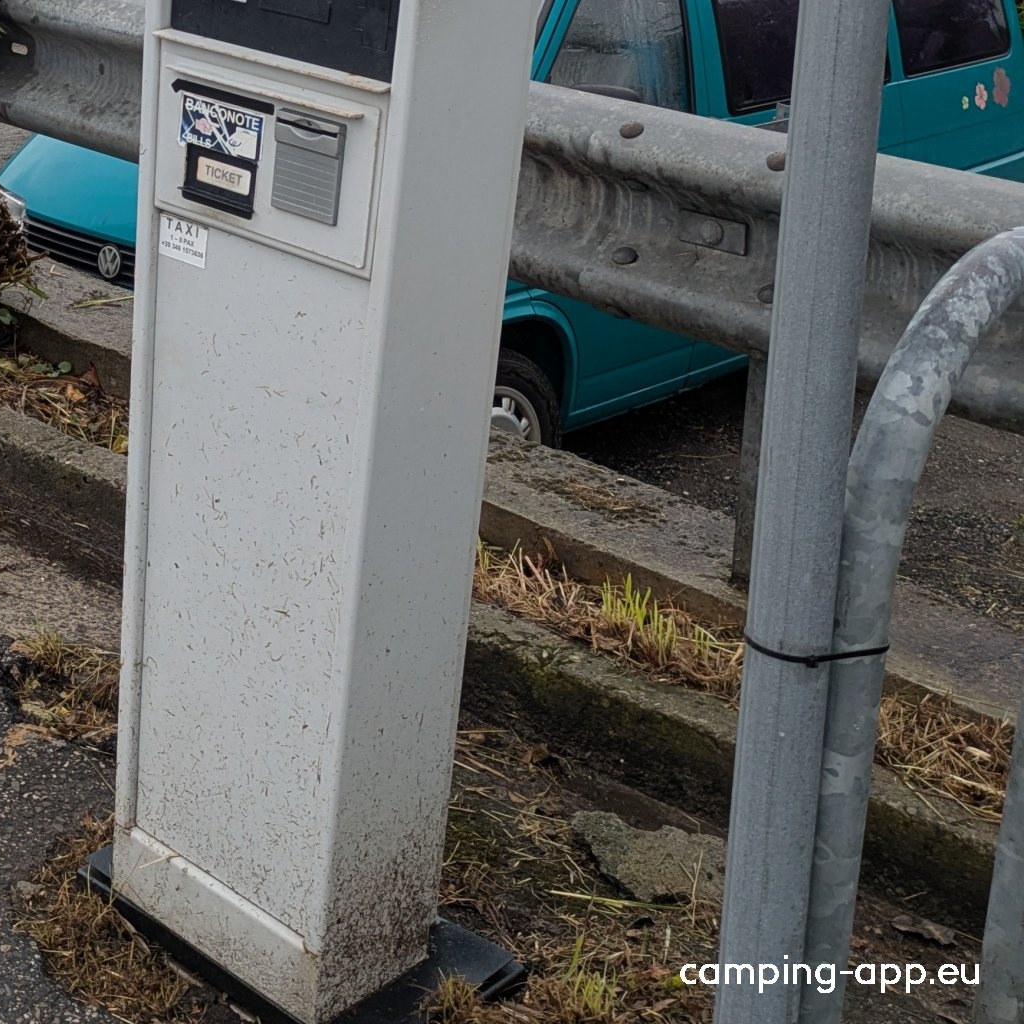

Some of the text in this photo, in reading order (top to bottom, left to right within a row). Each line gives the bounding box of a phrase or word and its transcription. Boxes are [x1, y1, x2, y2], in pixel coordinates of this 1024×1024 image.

[185, 97, 260, 131] BANCONOTE
[186, 132, 212, 149] BILLS
[205, 164, 243, 186] TICKET
[166, 217, 199, 238] TAXI
[183, 238, 194, 247] PAX
